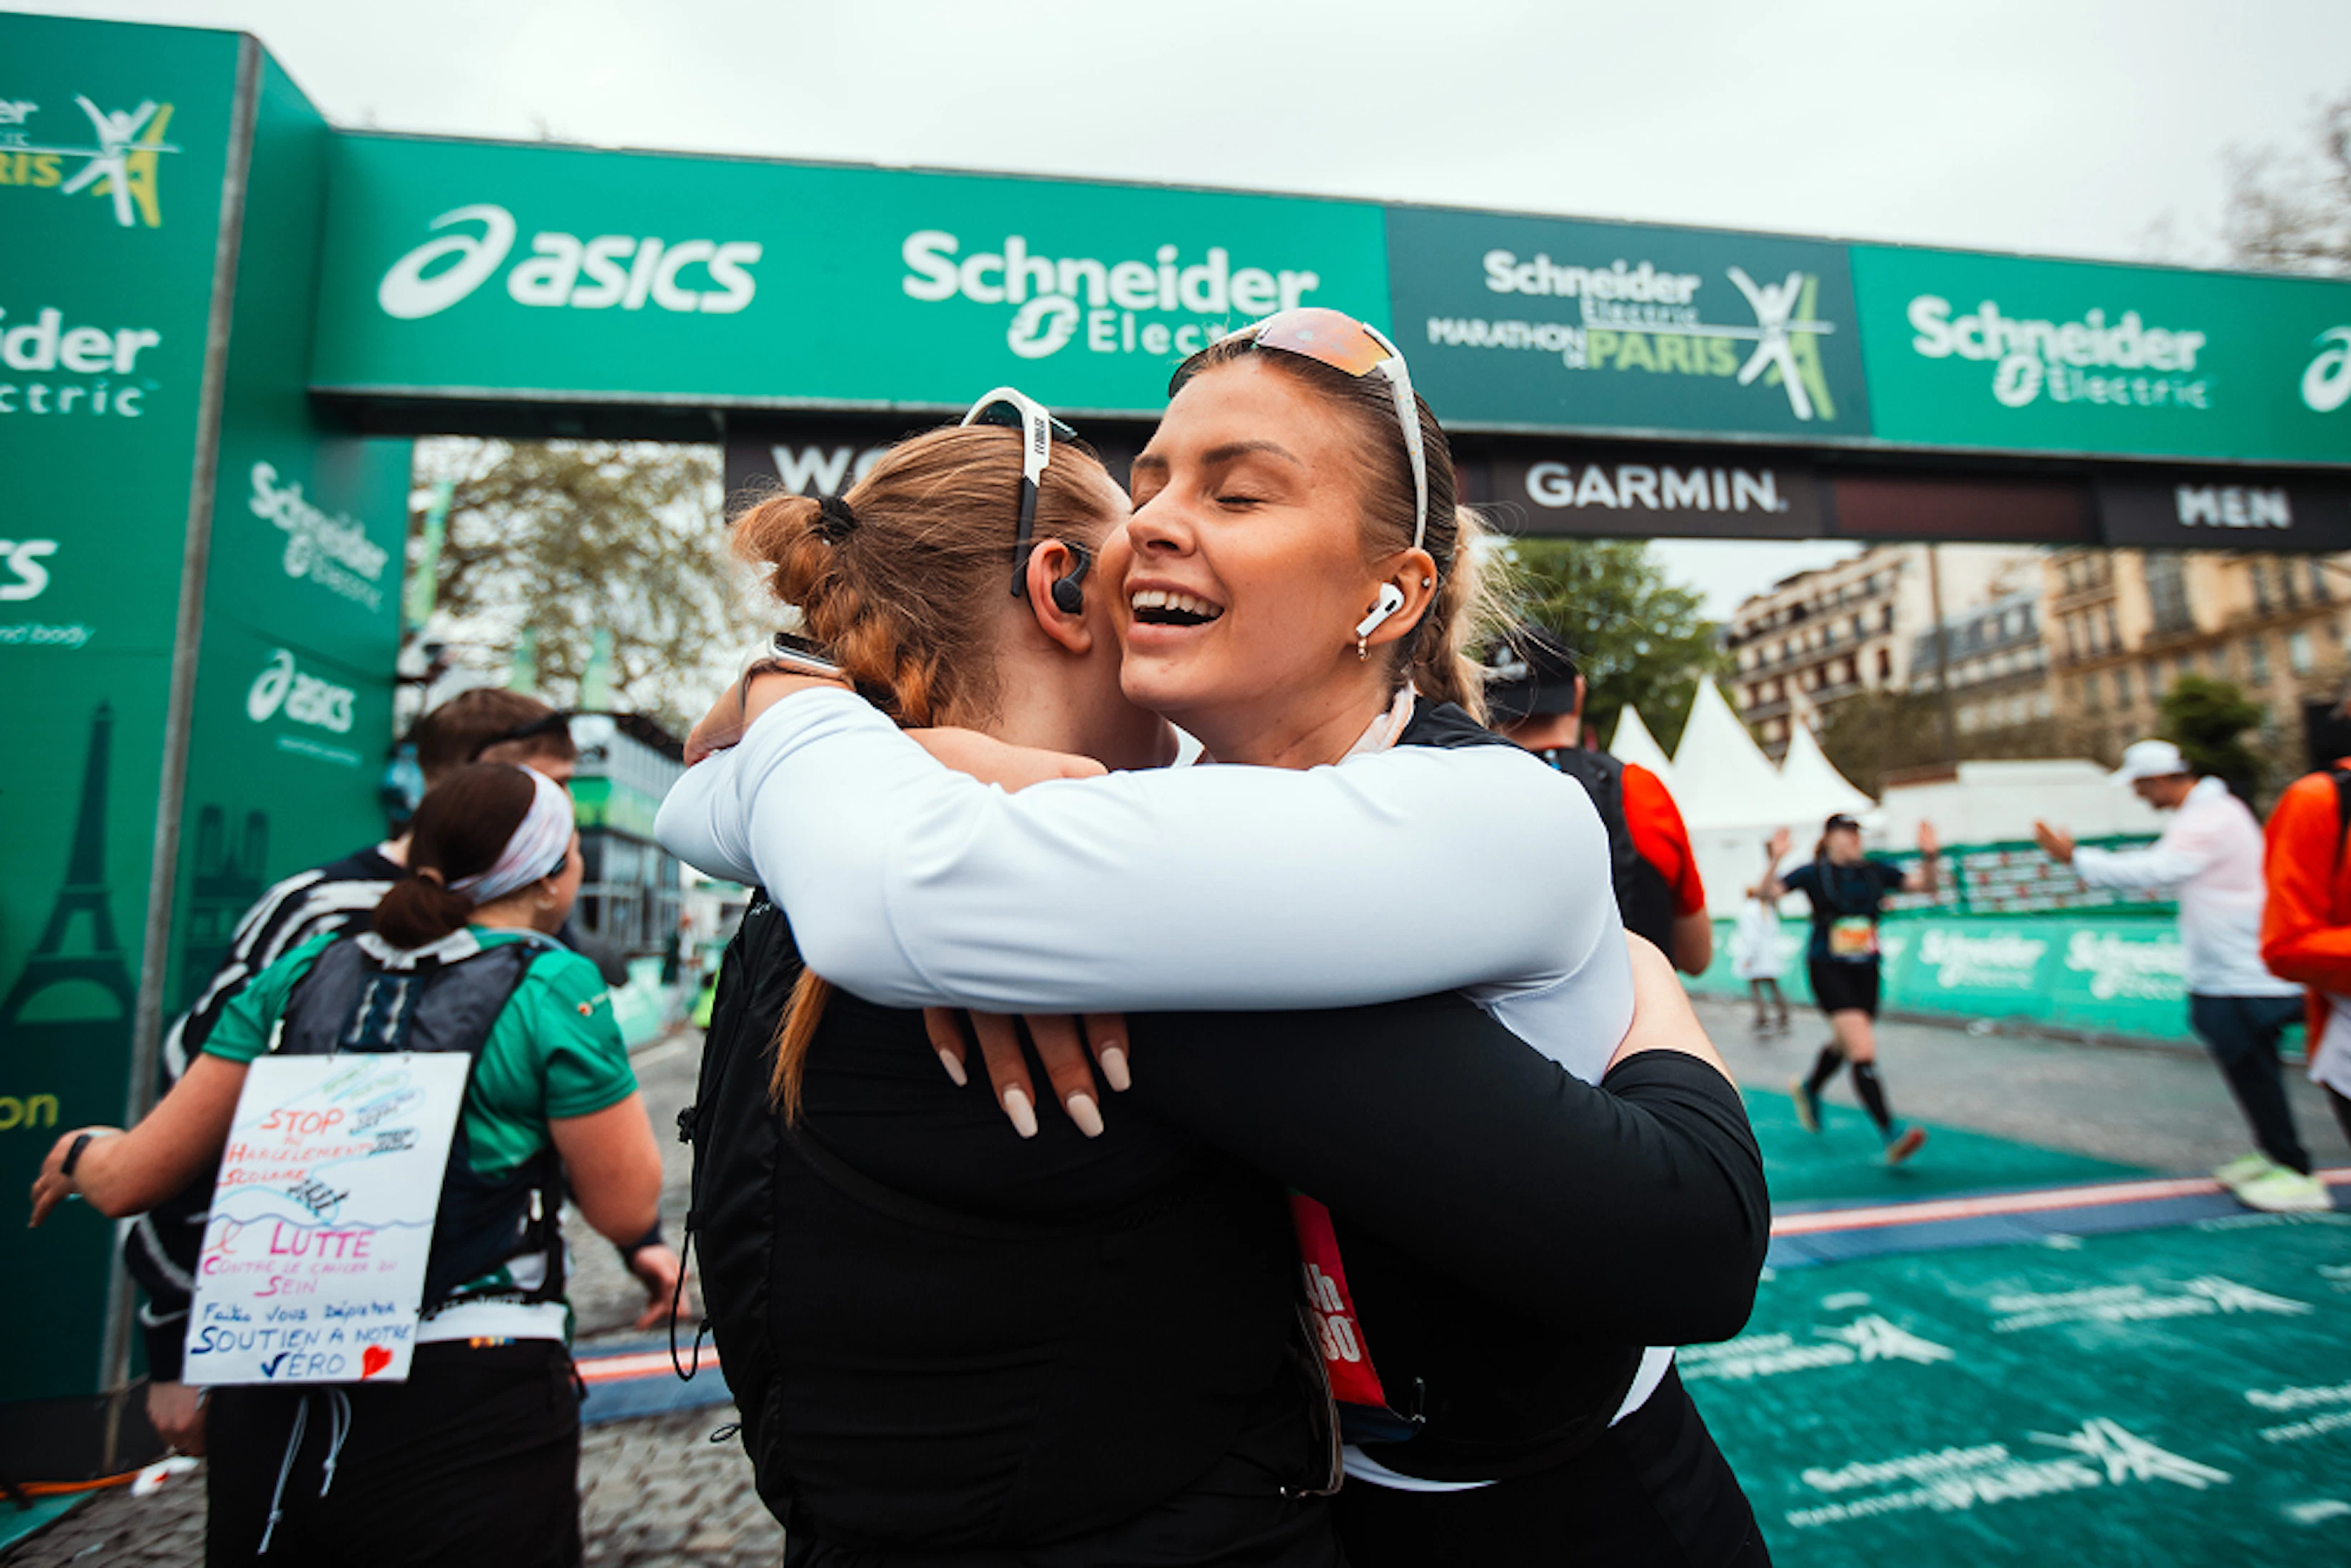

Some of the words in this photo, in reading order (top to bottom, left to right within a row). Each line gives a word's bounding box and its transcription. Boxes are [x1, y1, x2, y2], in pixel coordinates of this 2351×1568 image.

[901, 229, 1320, 315] Schneider
[1482, 249, 1702, 305] Schneider
[0, 305, 163, 375] der
[1426, 317, 1588, 352] MARATHON
[1586, 328, 1740, 378] PARIS
[1906, 294, 2205, 373] Schneider
[1525, 462, 1778, 512] GARMIN
[2175, 484, 2292, 530] MEN
[259, 1108, 345, 1136] STOP
[270, 1221, 376, 1258] LUTTE
[254, 1275, 319, 1298] SEIN
[190, 1326, 322, 1354] SOUTIEN
